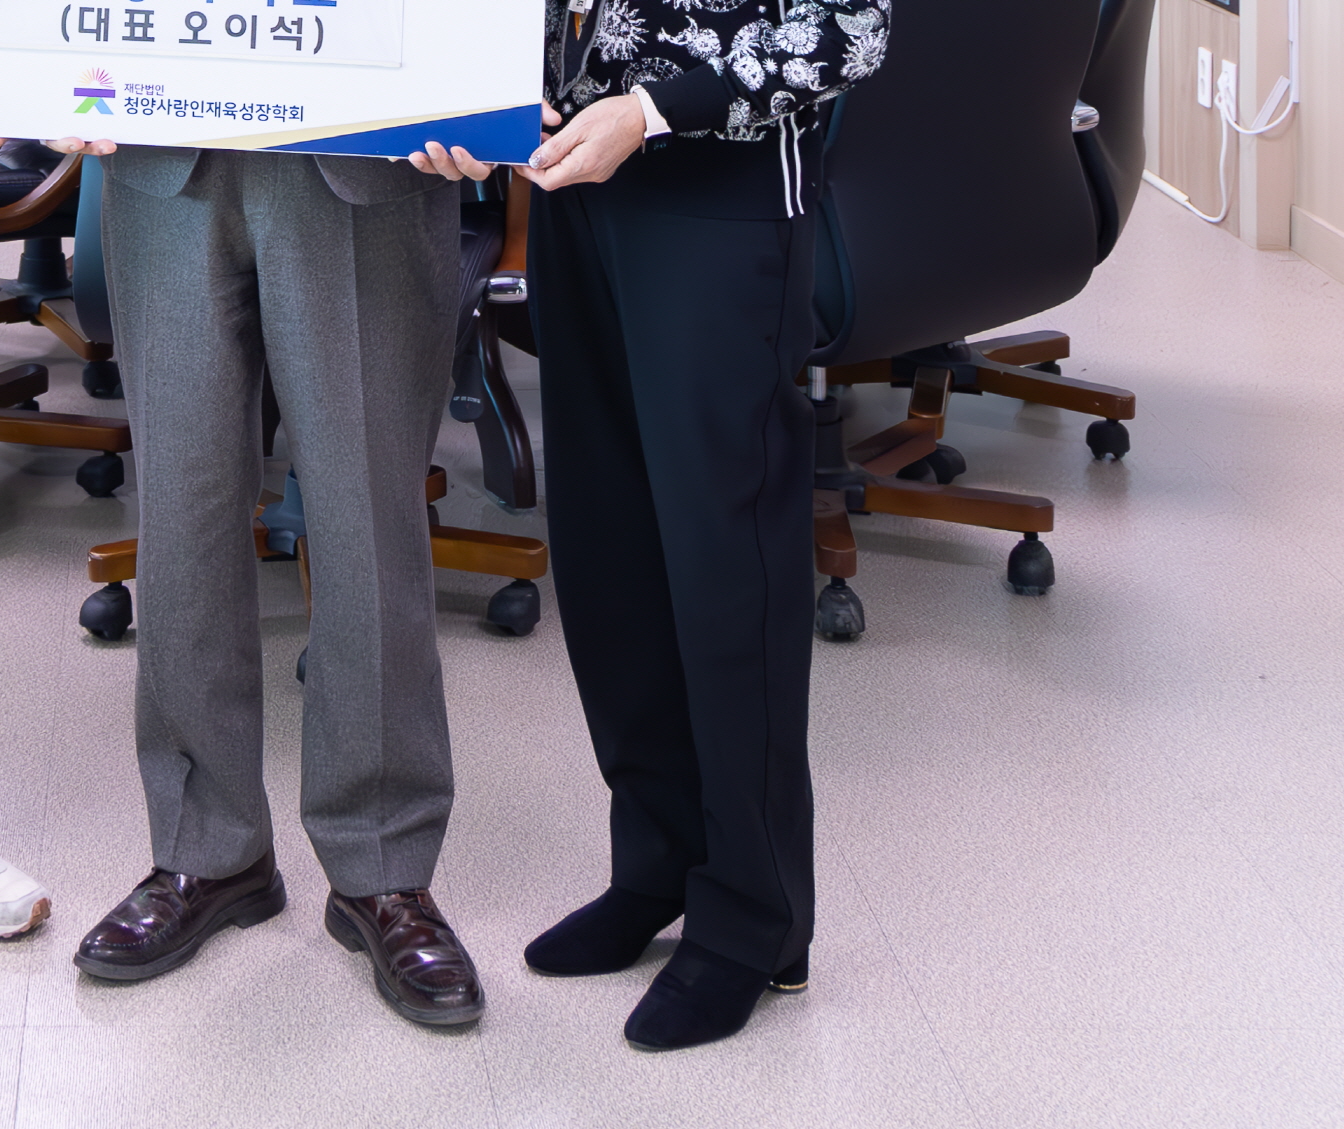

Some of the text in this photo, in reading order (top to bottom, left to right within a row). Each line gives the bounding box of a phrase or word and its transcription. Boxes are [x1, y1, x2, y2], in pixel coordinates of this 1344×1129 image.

[61, 4, 324, 55] (대표 오이석)
[124, 83, 165, 96] 재단법인
[124, 96, 304, 123] 청양사랑인재육성장학회
